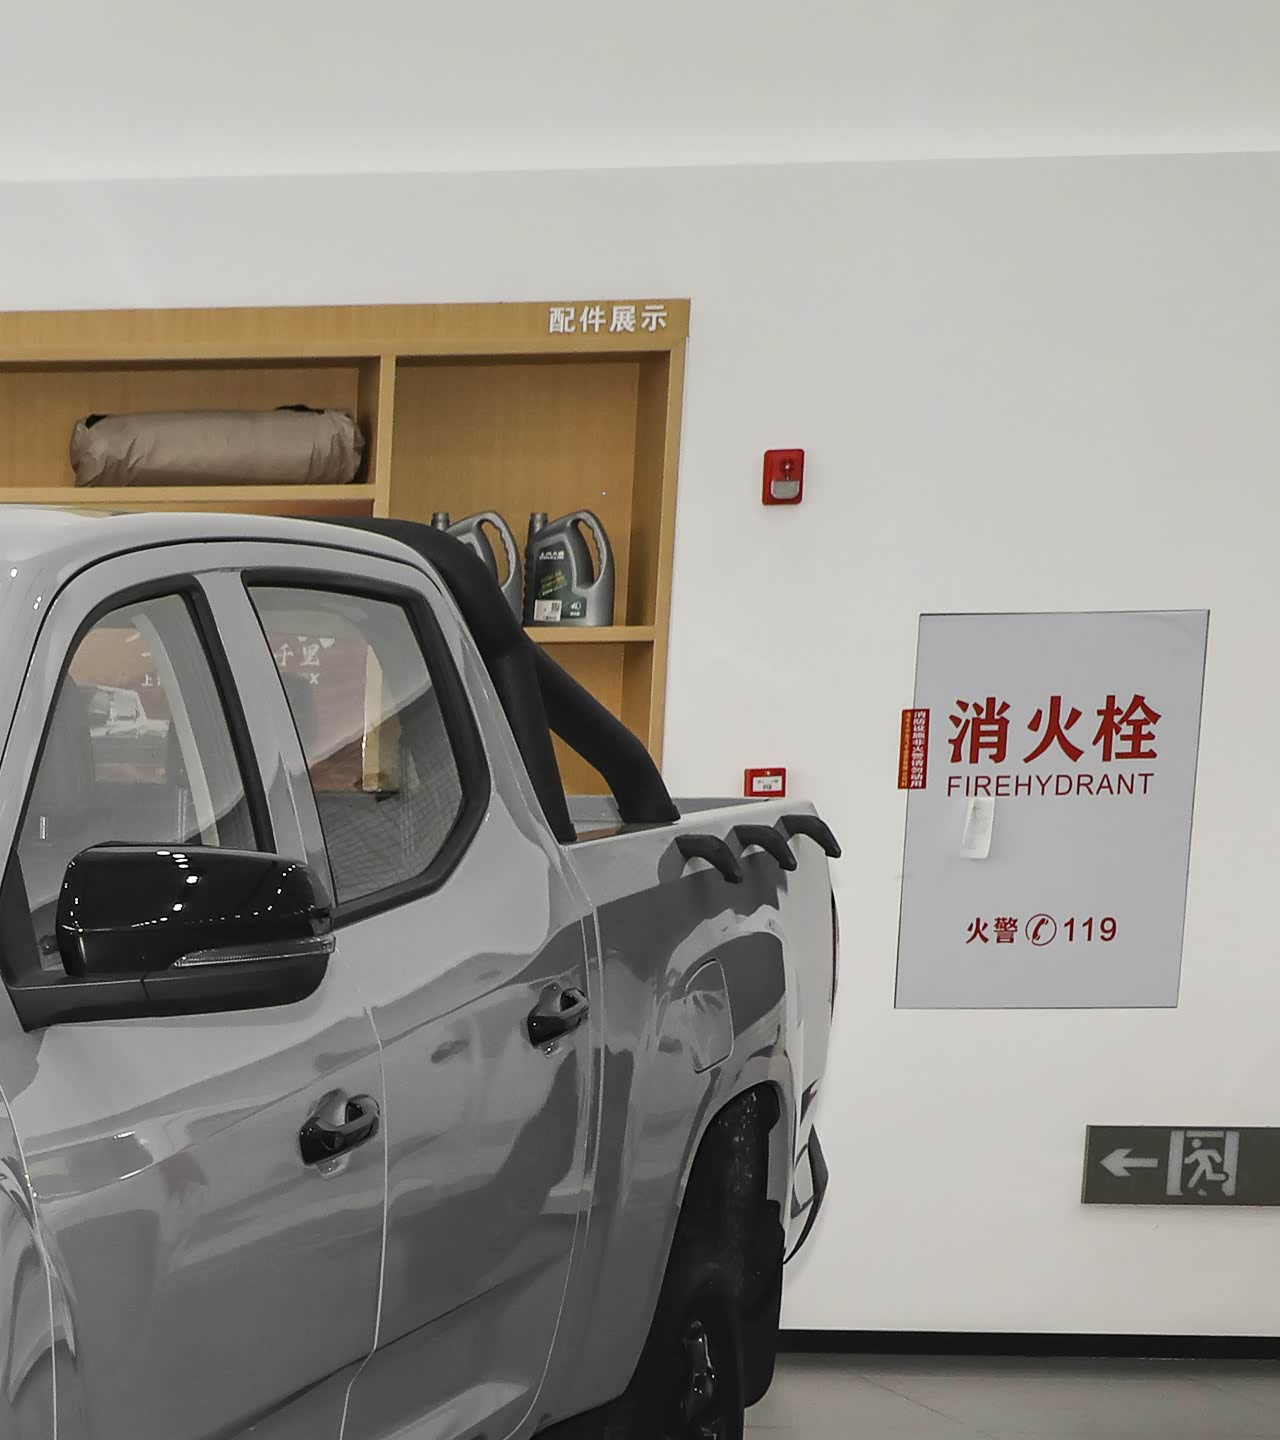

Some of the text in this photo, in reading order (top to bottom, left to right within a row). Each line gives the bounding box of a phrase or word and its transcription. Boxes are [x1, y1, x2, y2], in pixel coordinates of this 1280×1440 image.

[548, 303, 667, 334] 配件展示
[947, 694, 1162, 766] 消火栓
[946, 772, 1155, 798] FIREHYDRANT
[965, 917, 1118, 945] 火警 119
